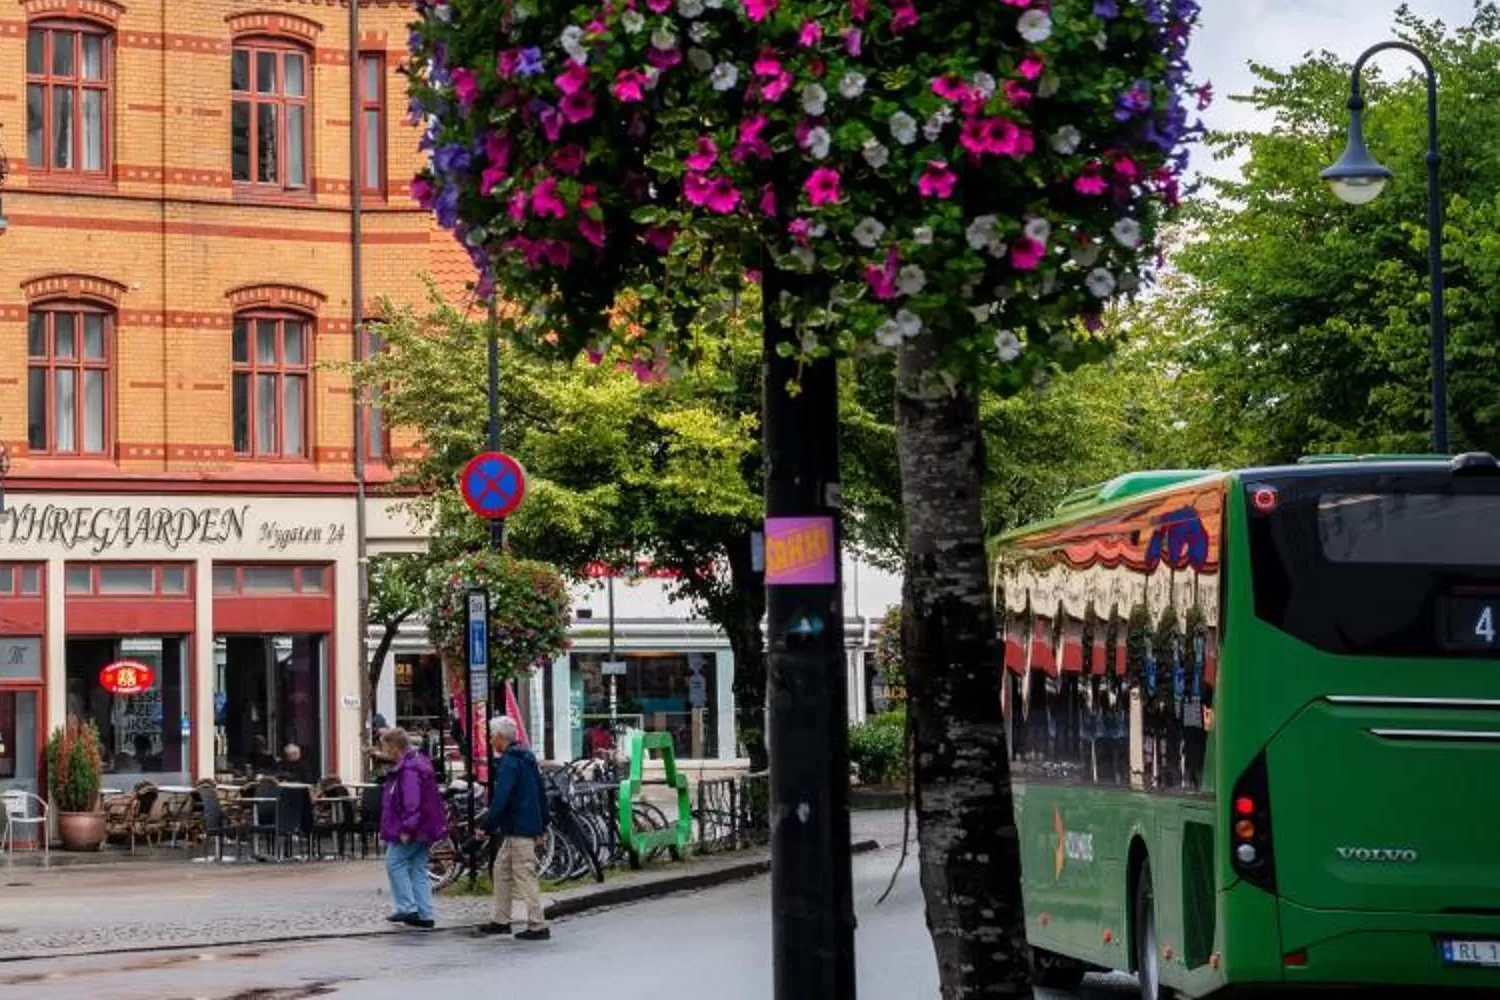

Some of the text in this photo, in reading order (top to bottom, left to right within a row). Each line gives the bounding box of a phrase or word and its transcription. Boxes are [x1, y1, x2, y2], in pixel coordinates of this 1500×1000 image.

[1475, 606, 1497, 642] 4
[1336, 847, 1418, 863] VOLVO
[1459, 943, 1482, 960] RL
